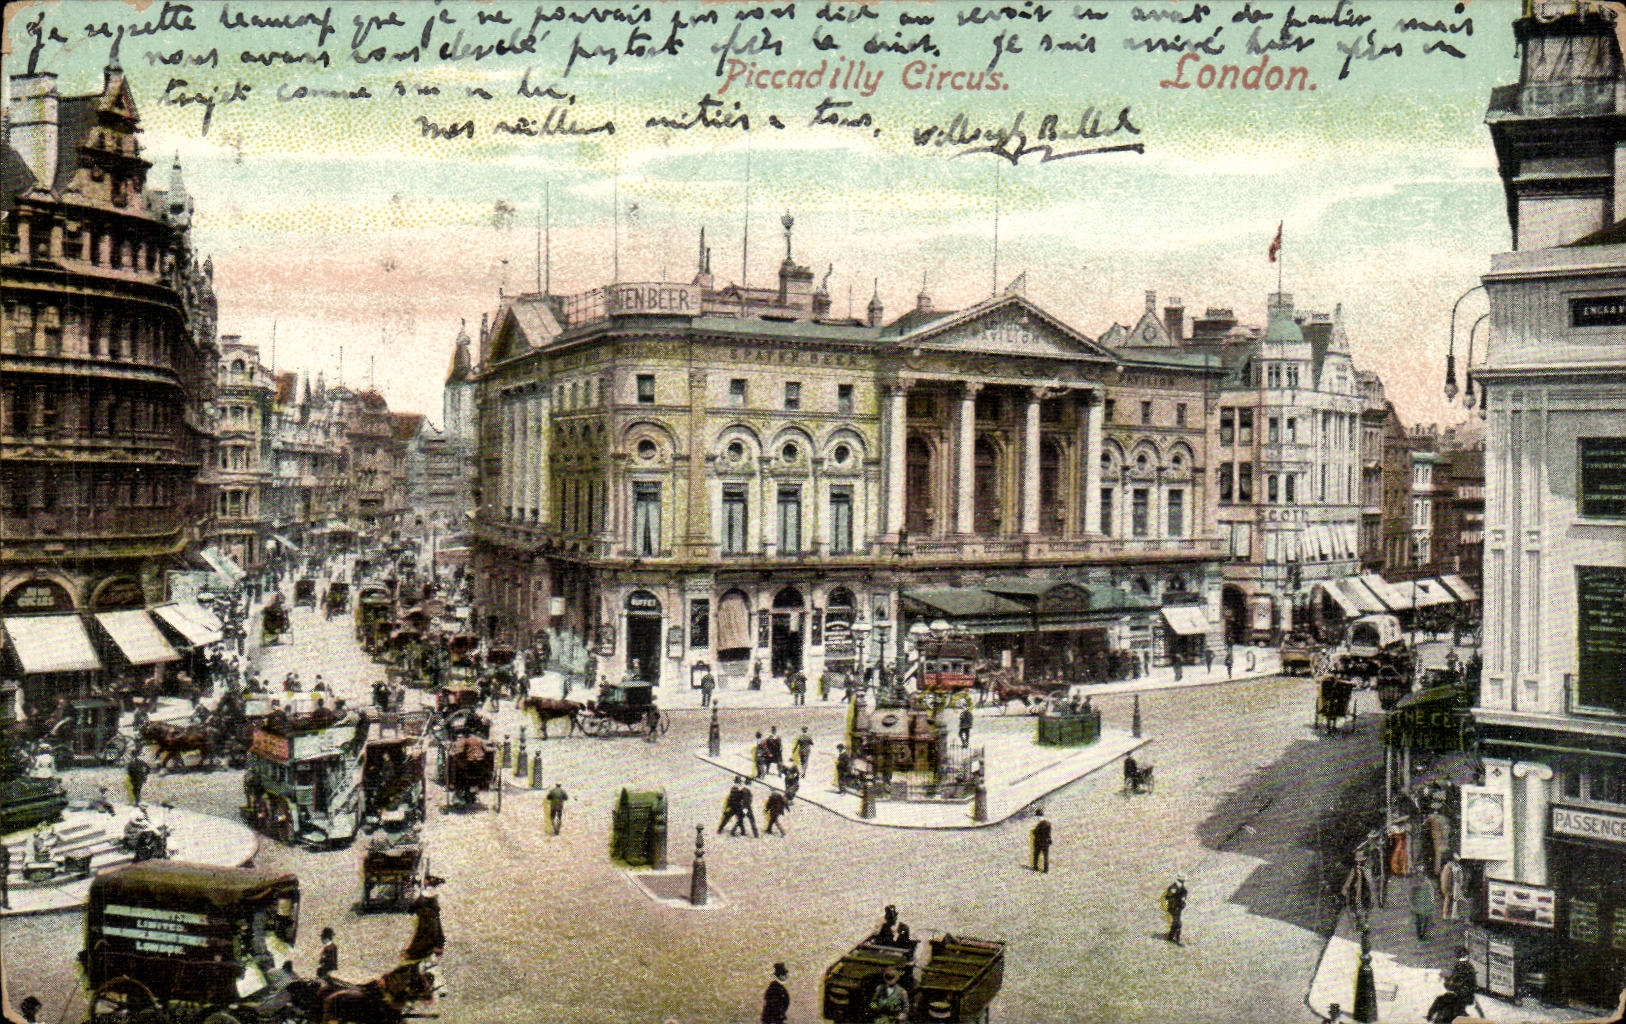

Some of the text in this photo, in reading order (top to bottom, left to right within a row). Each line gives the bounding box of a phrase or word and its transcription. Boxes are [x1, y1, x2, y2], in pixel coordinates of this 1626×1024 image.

[85, 2, 196, 68] regrette
[220, 3, 335, 47] beaucoup
[351, 11, 405, 49] que
[420, 0, 456, 49] je
[473, 10, 512, 25] ne
